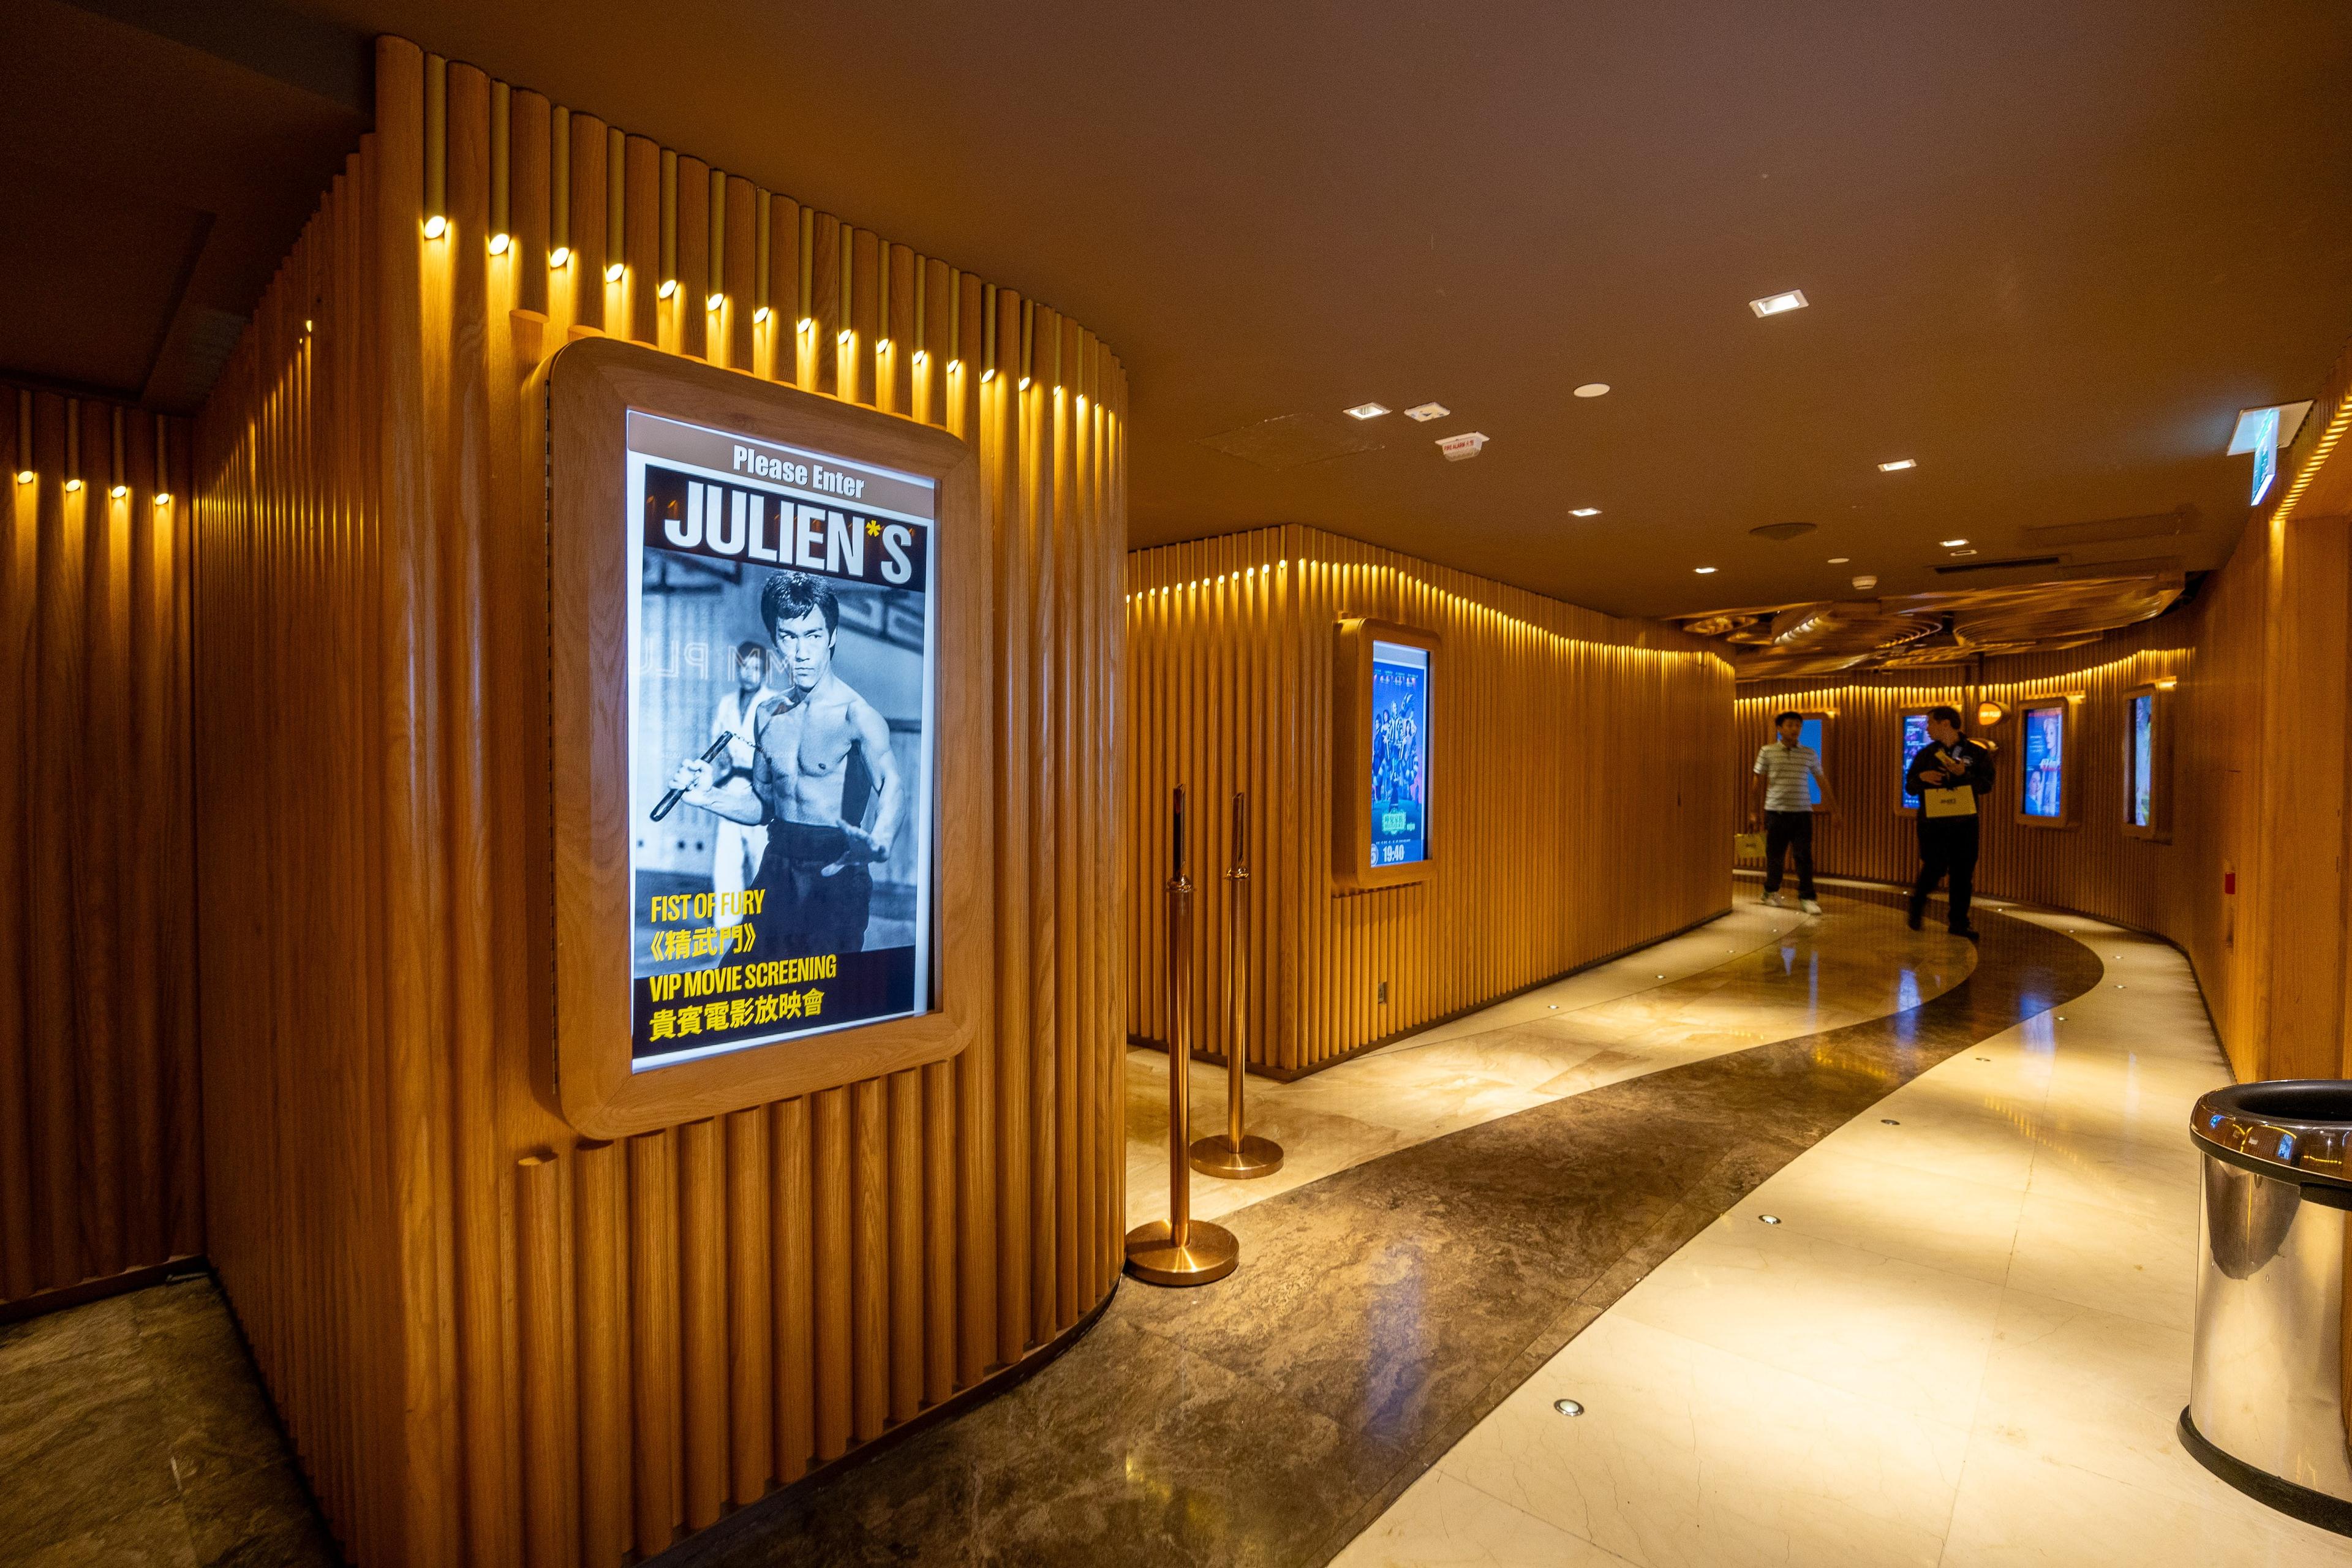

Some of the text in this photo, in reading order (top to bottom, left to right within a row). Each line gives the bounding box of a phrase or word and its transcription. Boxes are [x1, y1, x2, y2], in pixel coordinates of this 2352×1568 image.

[733, 445, 864, 499] Please Enter
[1383, 844, 1404, 862] 19:40
[651, 889, 765, 922] FIST OF FURY
[649, 954, 837, 1002] VIP MOVIE SCREENING
[649, 987, 824, 1042] 貴賓電影放映會
